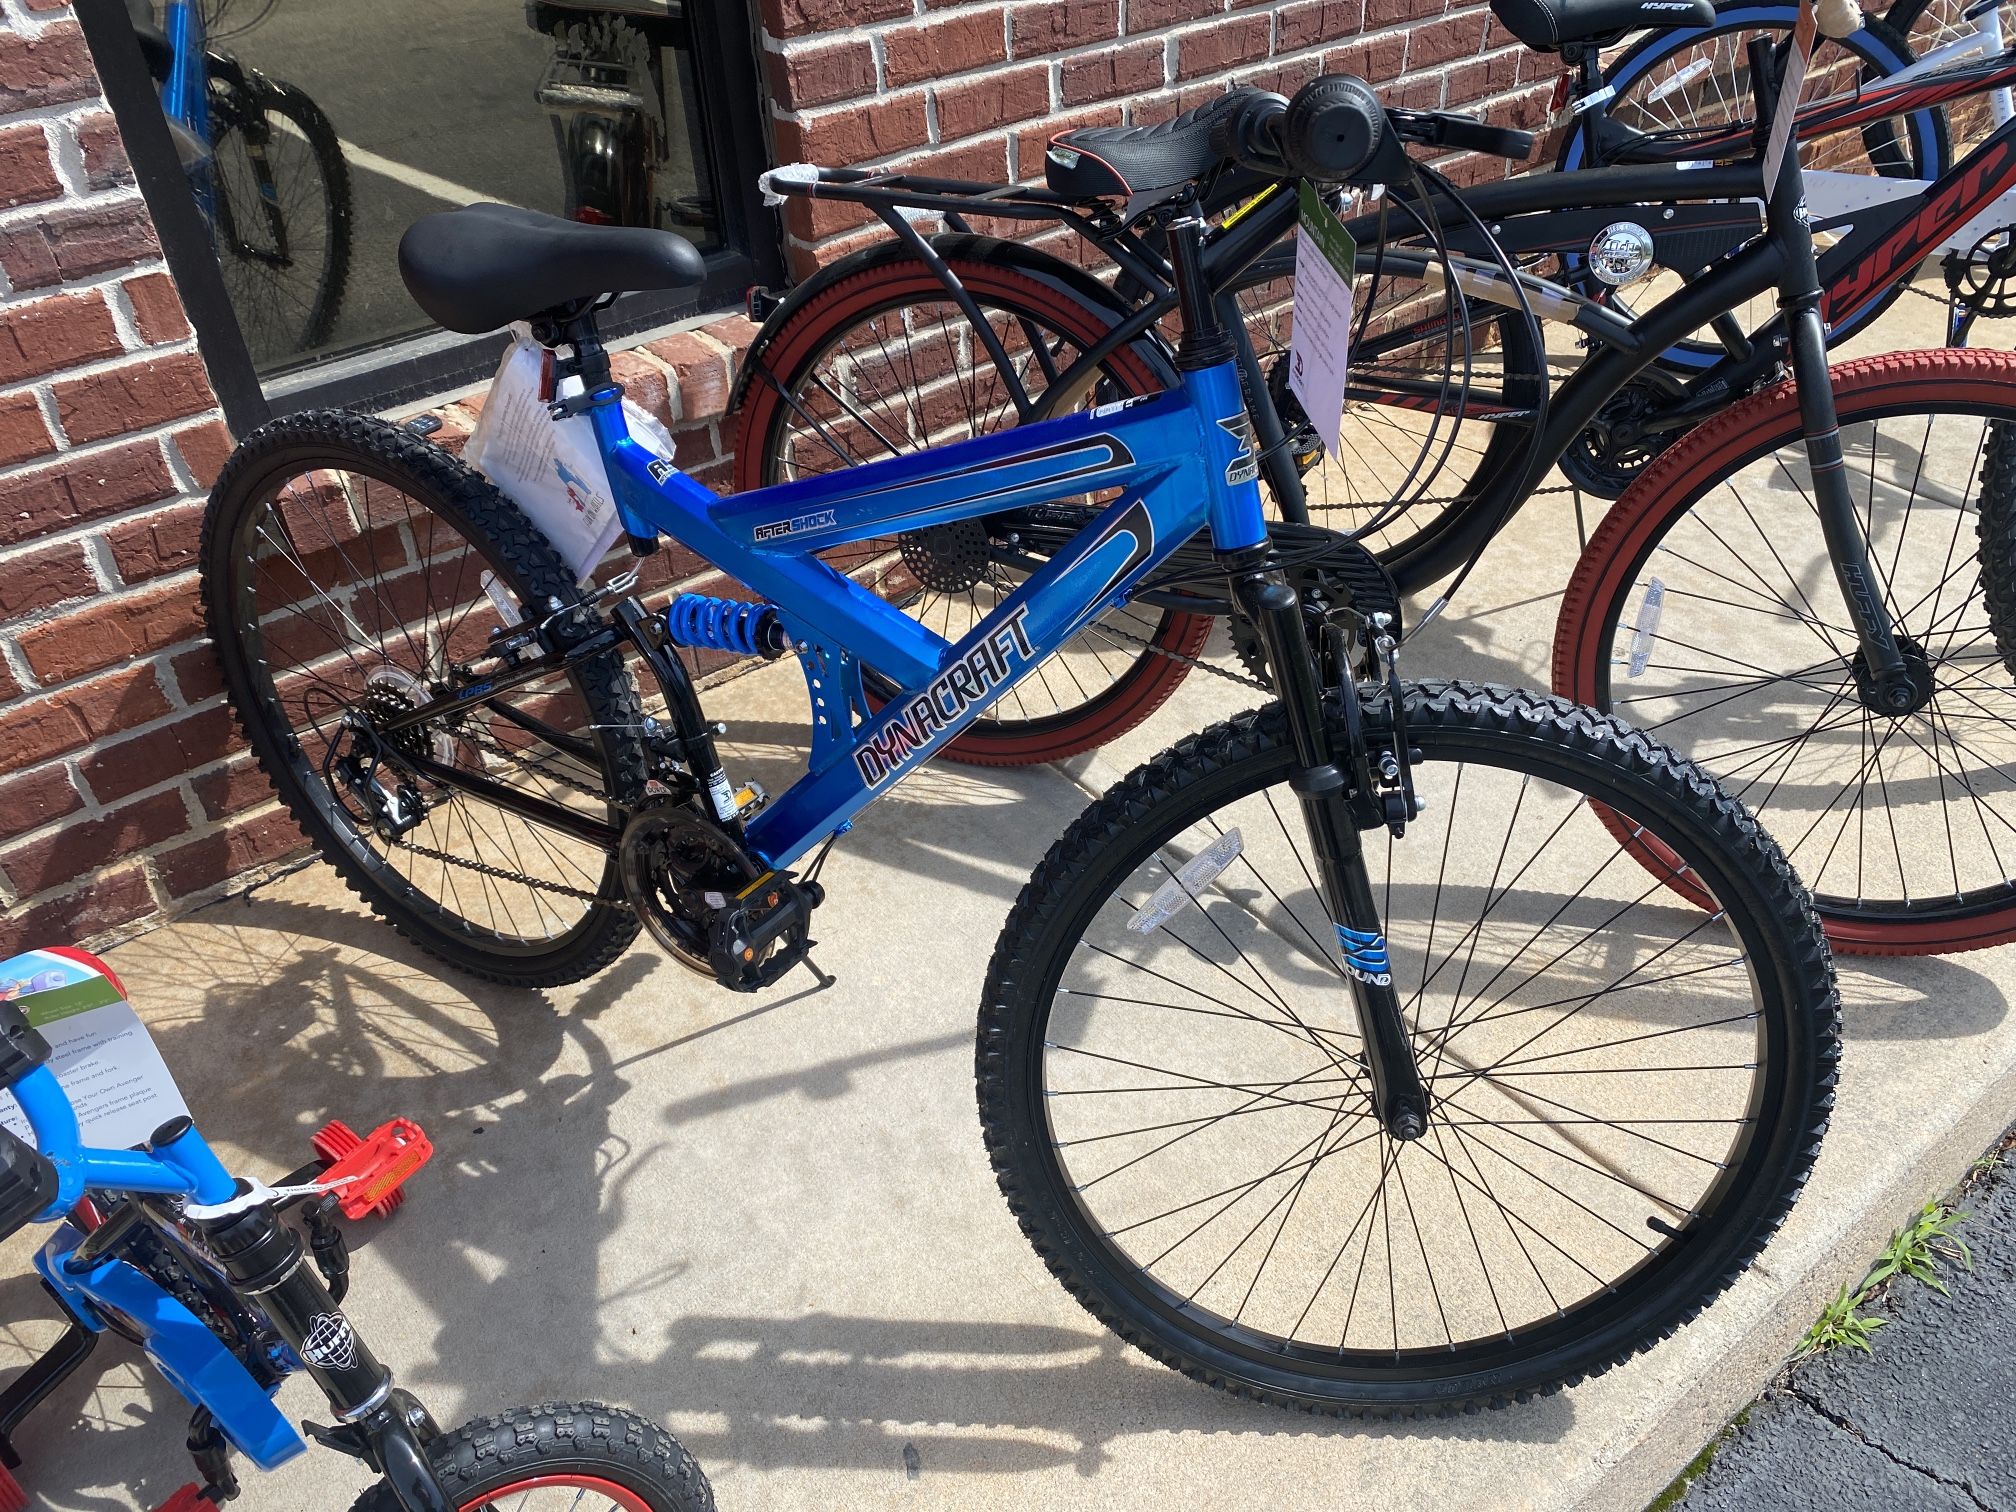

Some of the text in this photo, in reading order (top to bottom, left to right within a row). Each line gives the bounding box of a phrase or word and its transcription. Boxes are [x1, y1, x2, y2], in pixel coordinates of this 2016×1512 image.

[1640, 2, 1695, 11] HYPER
[1840, 562, 1890, 650] HUFFY
[852, 601, 1035, 790] DYNACRAFT
[72, 1045, 92, 1056] frame
[93, 1038, 107, 1049] with
[70, 1076, 91, 1087] frame
[91, 1071, 105, 1080] and
[99, 1085, 116, 1095] Own
[78, 1102, 109, 1118] Avengers
[109, 1095, 129, 1106] frame
